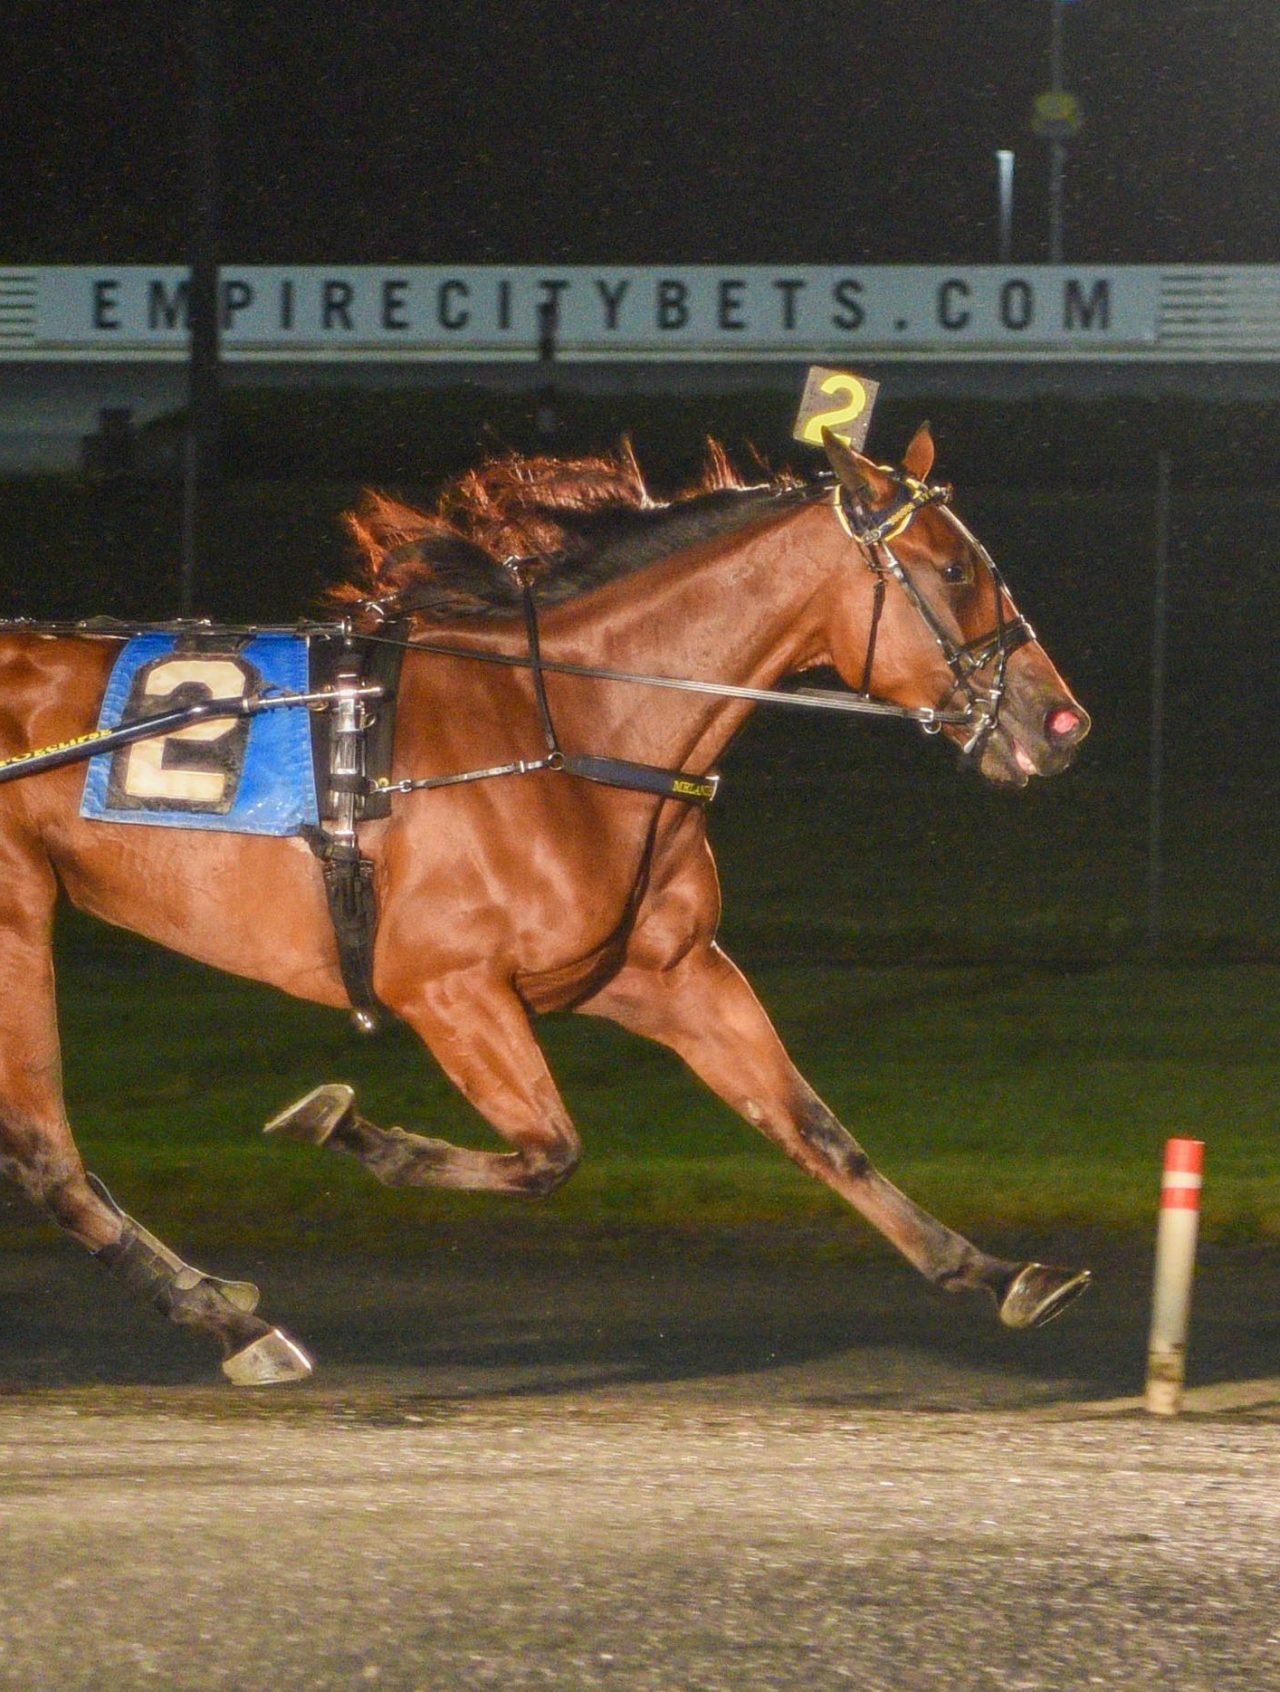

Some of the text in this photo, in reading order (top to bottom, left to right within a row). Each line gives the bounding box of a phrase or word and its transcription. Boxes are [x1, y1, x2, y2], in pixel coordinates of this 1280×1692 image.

[92, 279, 1112, 331] EMPIRECITYBETS.COM
[804, 375, 866, 446] 2
[125, 660, 246, 801] 2
